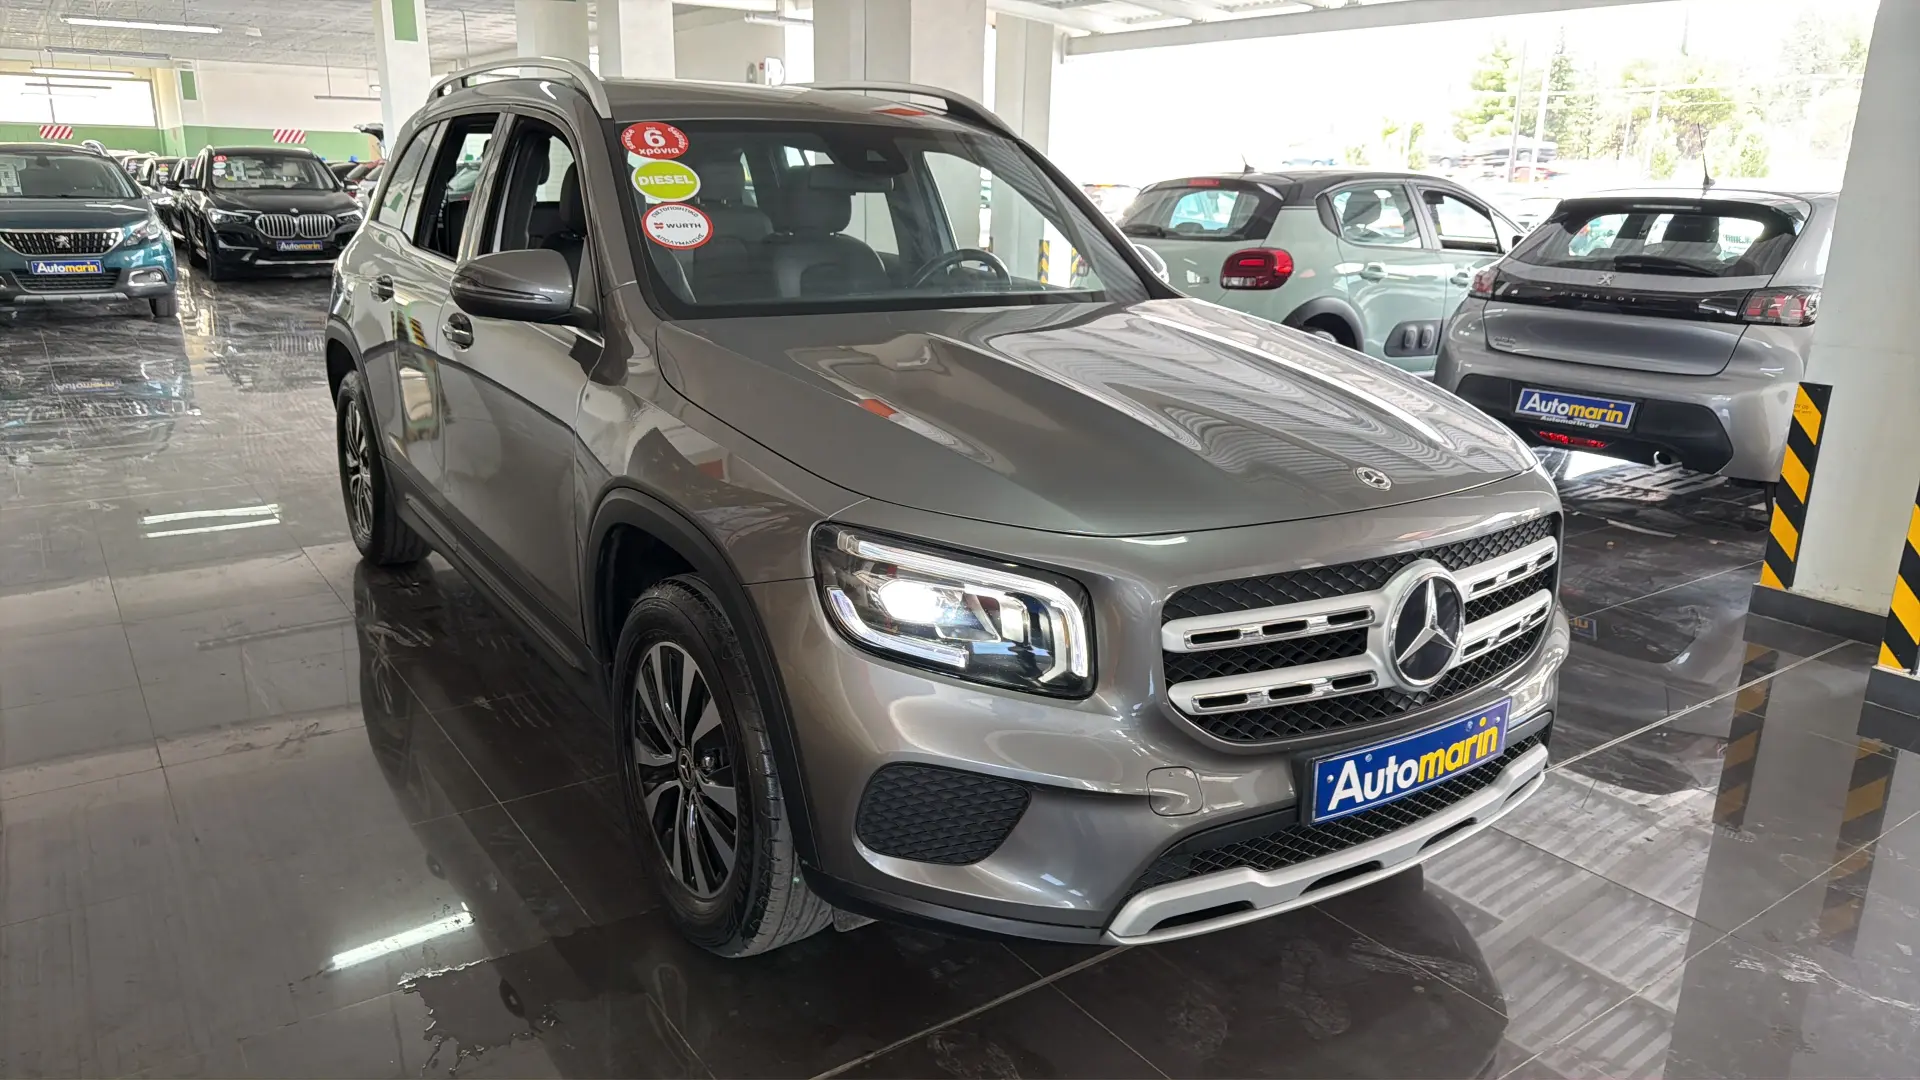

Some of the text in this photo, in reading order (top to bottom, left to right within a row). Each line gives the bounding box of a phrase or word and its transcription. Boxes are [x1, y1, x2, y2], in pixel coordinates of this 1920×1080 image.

[644, 129, 666, 147] 6
[638, 147, 680, 156] χρόνια
[637, 175, 694, 186] DIESEL
[280, 241, 321, 250] Automarin
[37, 261, 99, 273] Automarin
[1560, 291, 1637, 302] PEUGEOT
[1523, 393, 1624, 423] Automarin
[1327, 716, 1499, 811] Automarin
